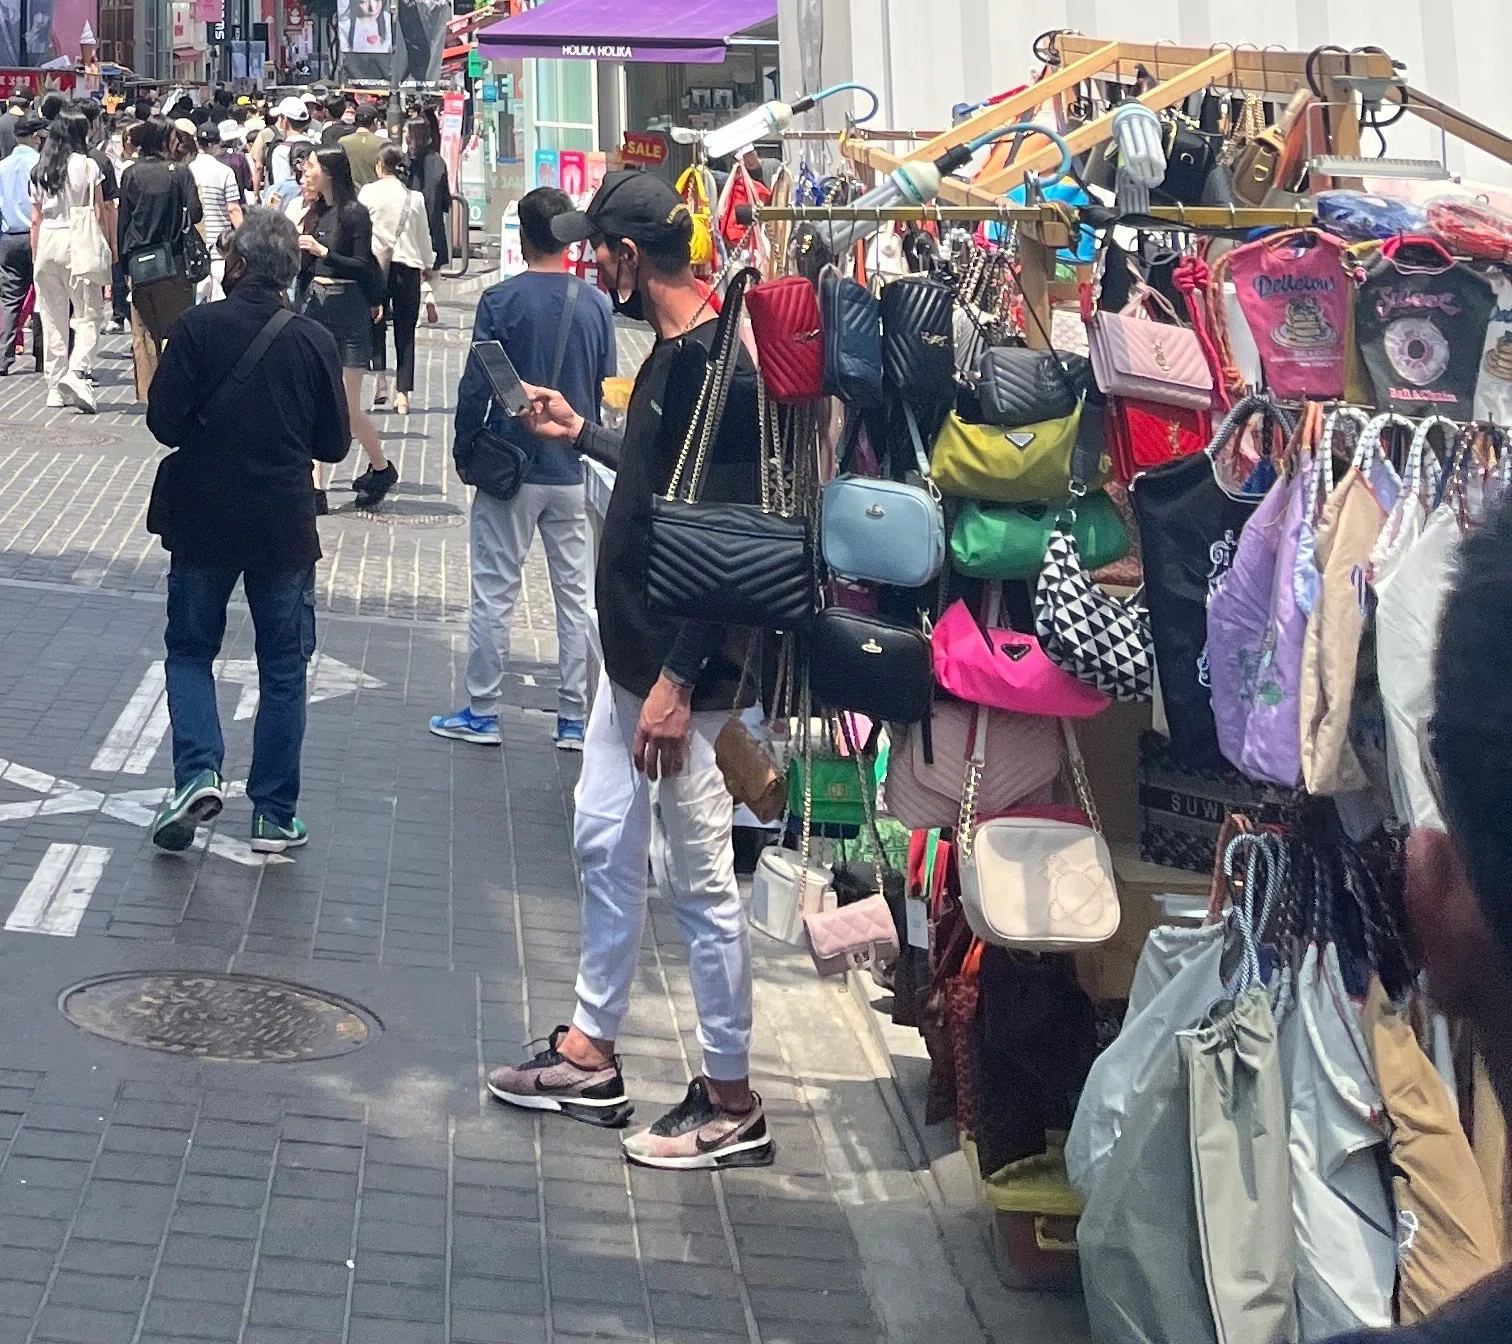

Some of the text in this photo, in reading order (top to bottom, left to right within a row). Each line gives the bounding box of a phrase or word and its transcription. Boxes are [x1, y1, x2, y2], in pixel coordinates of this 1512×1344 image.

[561, 44, 633, 58] HOLIKA HOLIKA
[627, 140, 662, 159] SALE
